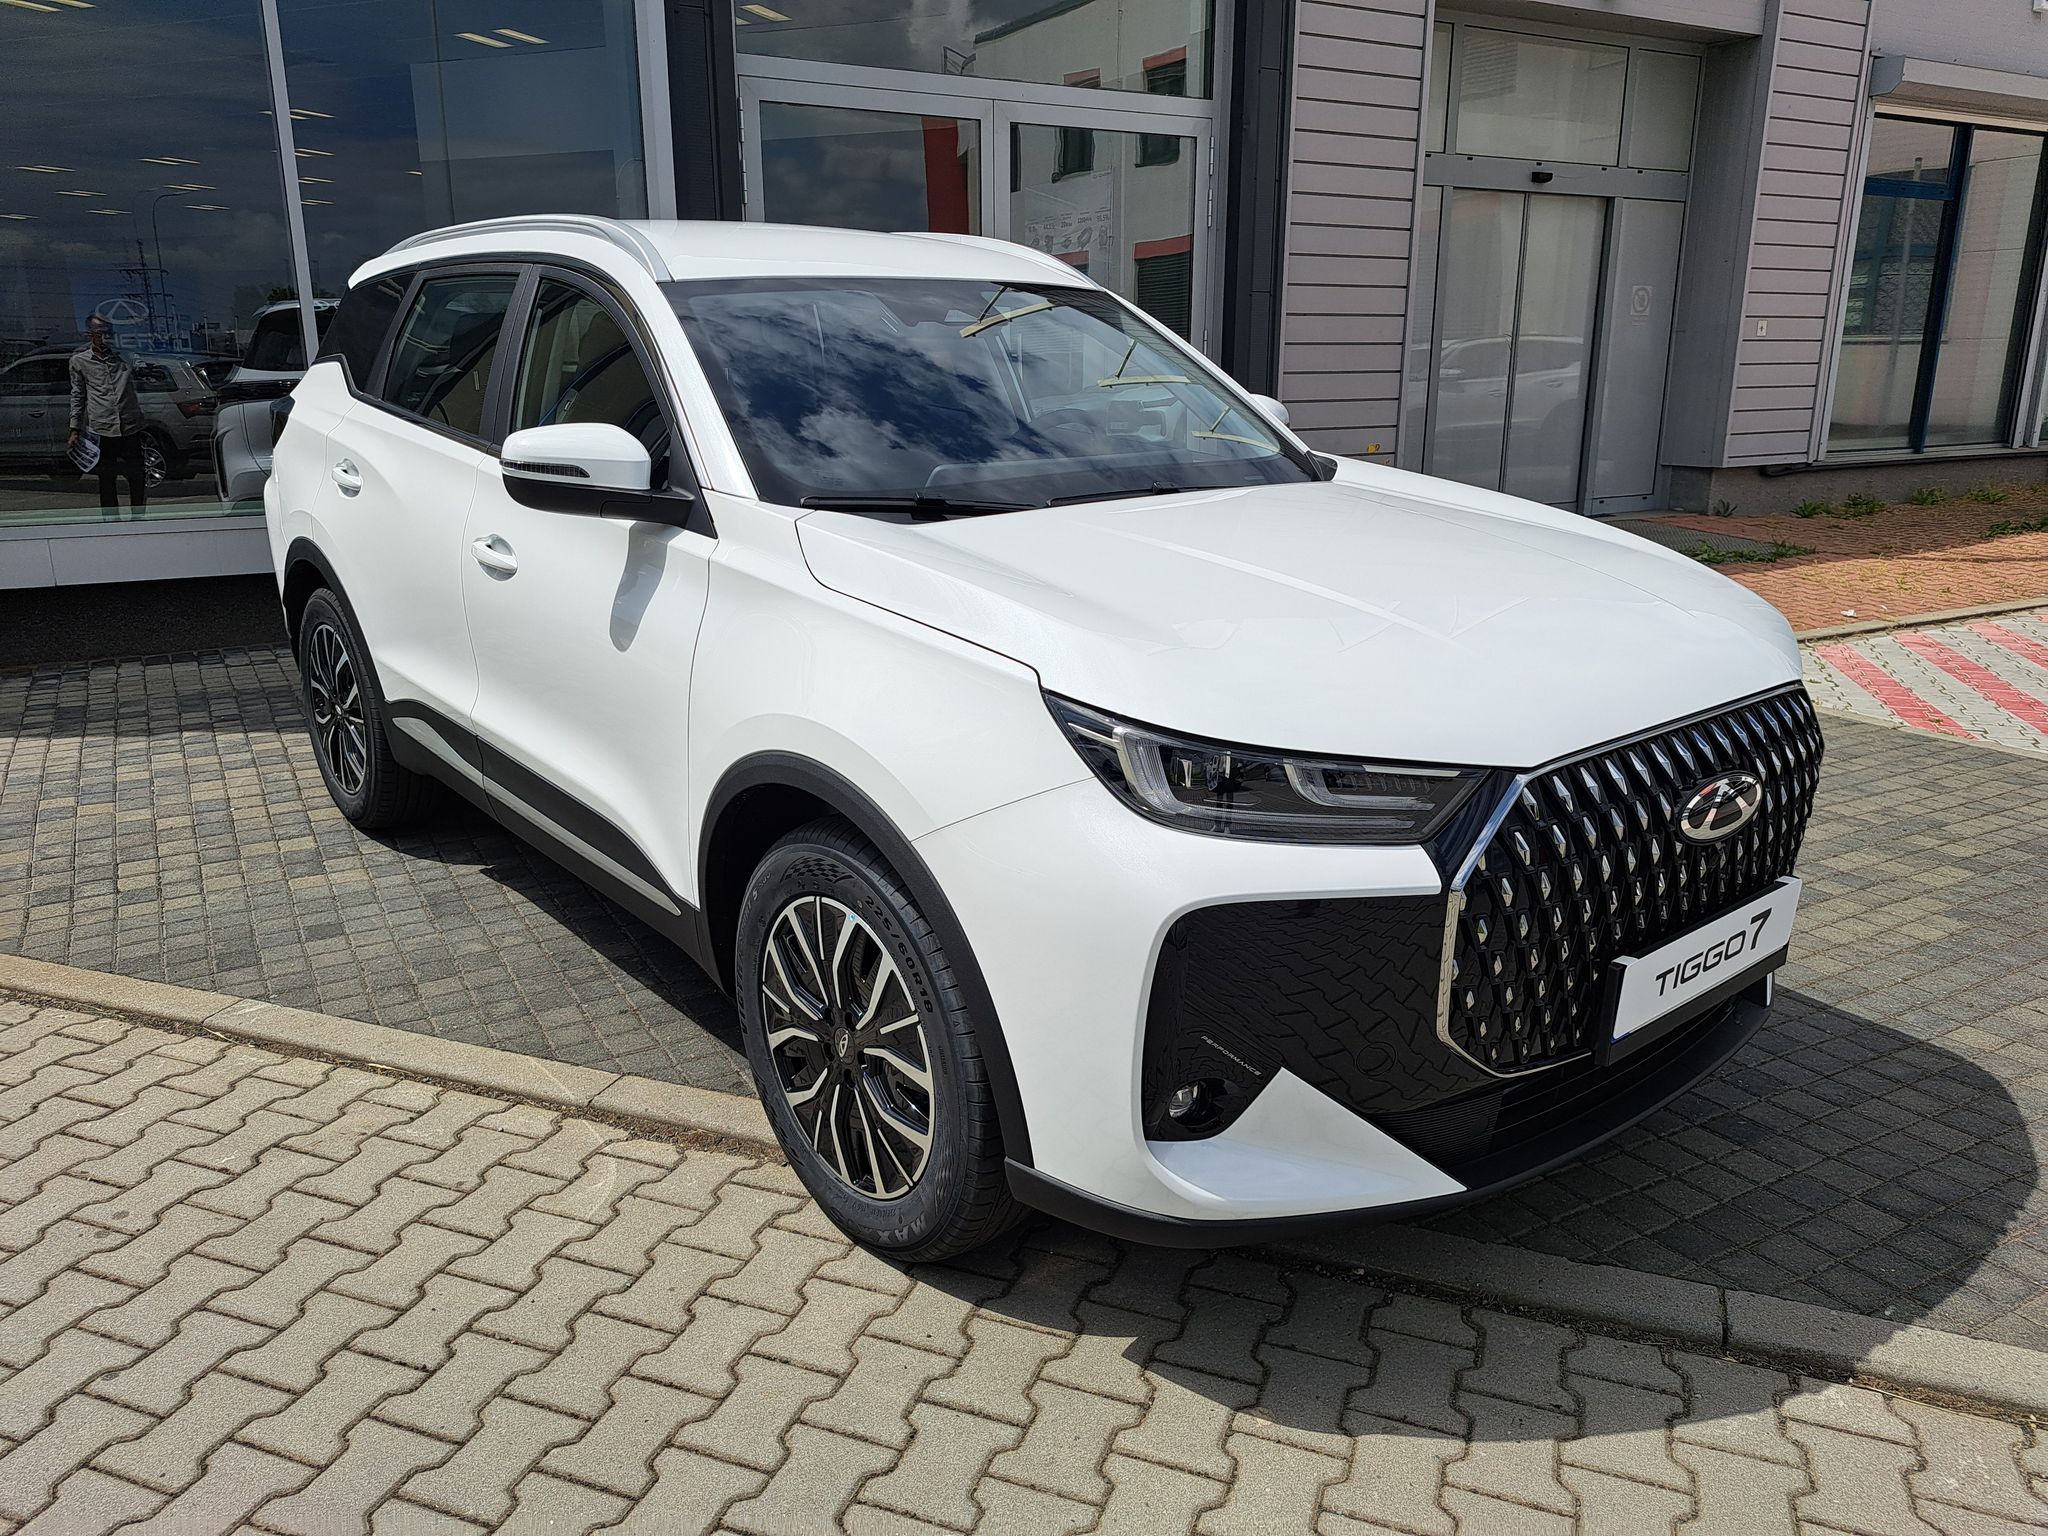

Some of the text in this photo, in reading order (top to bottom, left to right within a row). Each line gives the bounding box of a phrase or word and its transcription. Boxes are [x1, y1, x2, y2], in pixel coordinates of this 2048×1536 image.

[864, 896, 934, 1013] 225/60R18
[1655, 907, 1773, 997] TIGGO 7
[1200, 1035, 1262, 1076] PERFORMANCE
